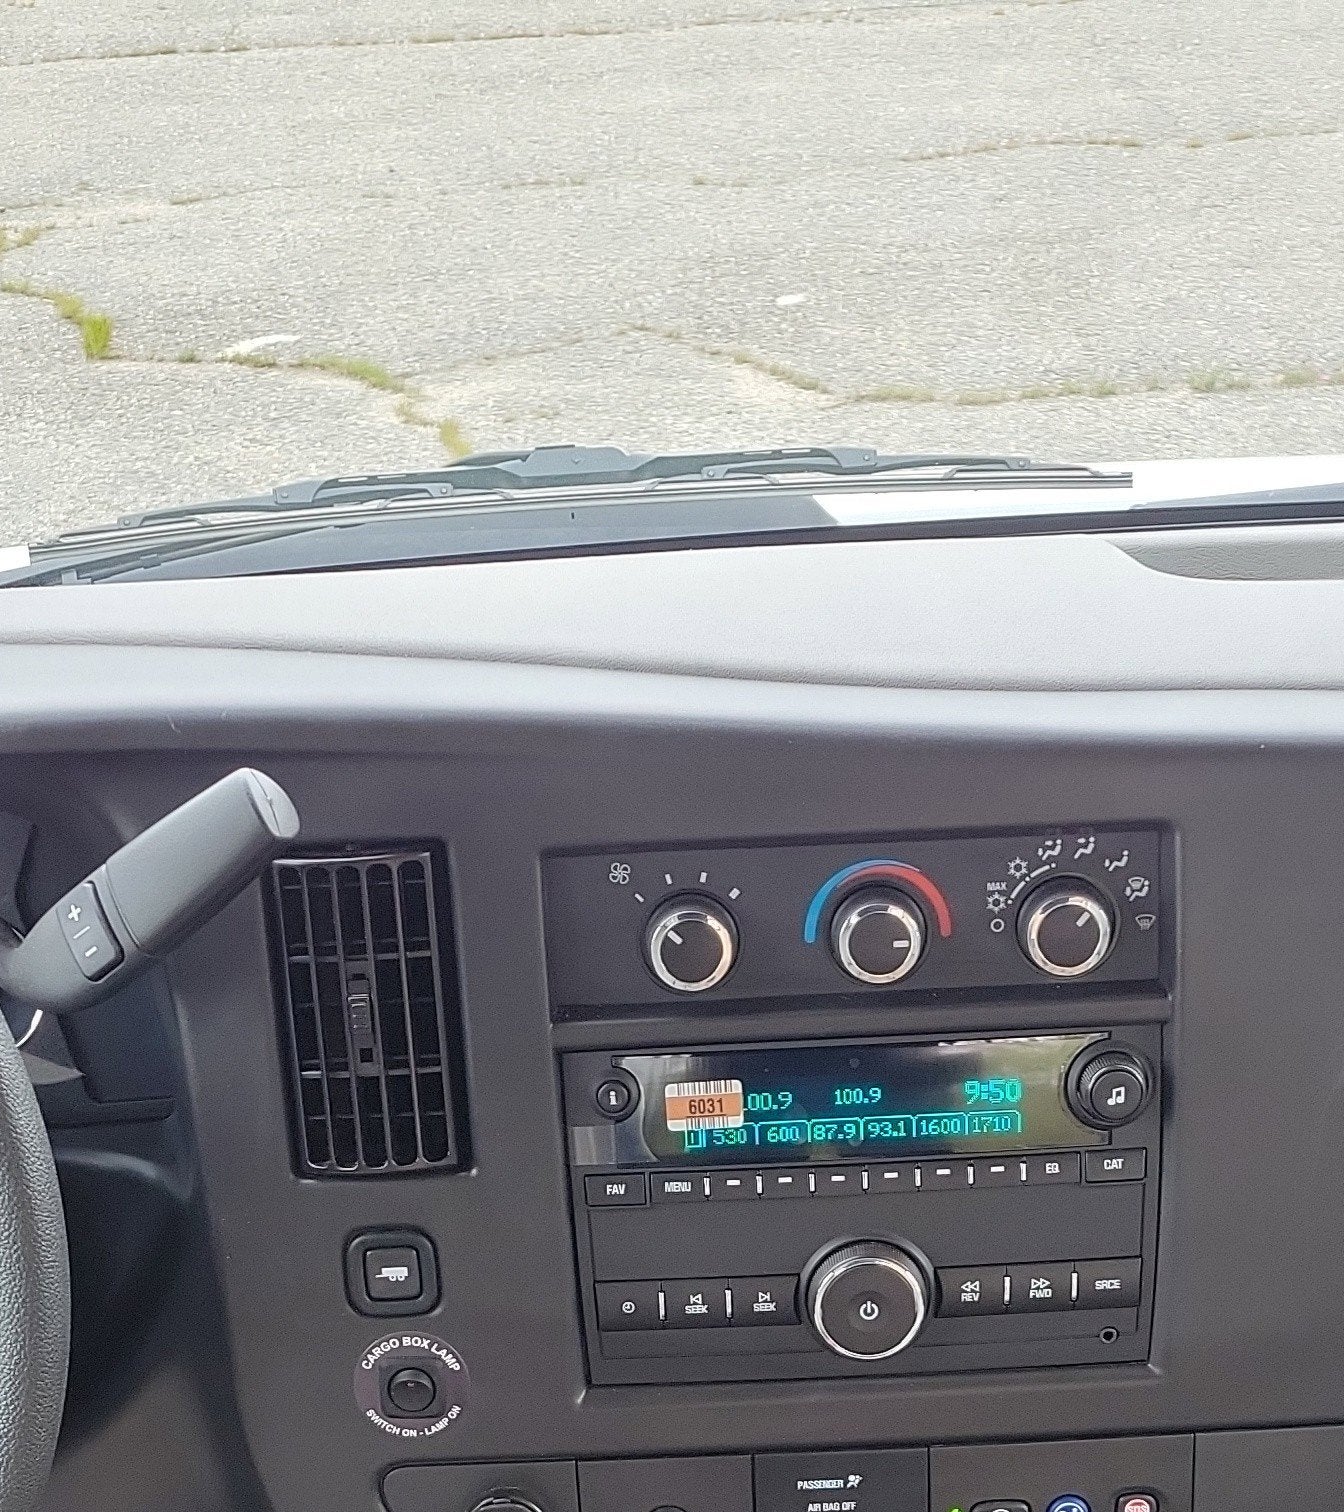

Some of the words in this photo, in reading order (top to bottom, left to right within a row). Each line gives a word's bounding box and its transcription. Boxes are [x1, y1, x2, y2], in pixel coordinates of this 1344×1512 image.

[987, 881, 1007, 891] MAX
[834, 1087, 882, 1105] 100.9
[964, 1079, 1022, 1104] 9:50
[688, 1097, 726, 1115] 6031
[743, 1091, 793, 1111] 00.9
[712, 1129, 747, 1145] 530
[767, 1126, 800, 1142] 600
[813, 1123, 856, 1141] 87.9
[868, 1121, 907, 1137] 93.1
[920, 1118, 961, 1135] 1600
[972, 1115, 1011, 1133] 1710
[1045, 1162, 1060, 1174] EQ
[1103, 1158, 1124, 1170] CAT
[606, 1184, 625, 1195] FAV
[664, 1181, 692, 1193] MENU
[961, 1292, 980, 1302] REV
[1029, 1288, 1052, 1298] FWD
[684, 1304, 708, 1314] SEEK
[753, 1302, 777, 1312] SEEK
[361, 1338, 400, 1370] CARGO
[402, 1336, 431, 1351] BOX
[430, 1343, 461, 1372] LAMP
[366, 1409, 400, 1436] SWITCH
[402, 1428, 417, 1437] ON
[424, 1418, 450, 1436] LAMP
[447, 1405, 462, 1420] ON
[797, 1479, 844, 1490] PASSENGER
[807, 1503, 821, 1512] AIR
[822, 1502, 840, 1511] BAG
[841, 1501, 856, 1511] OFF
